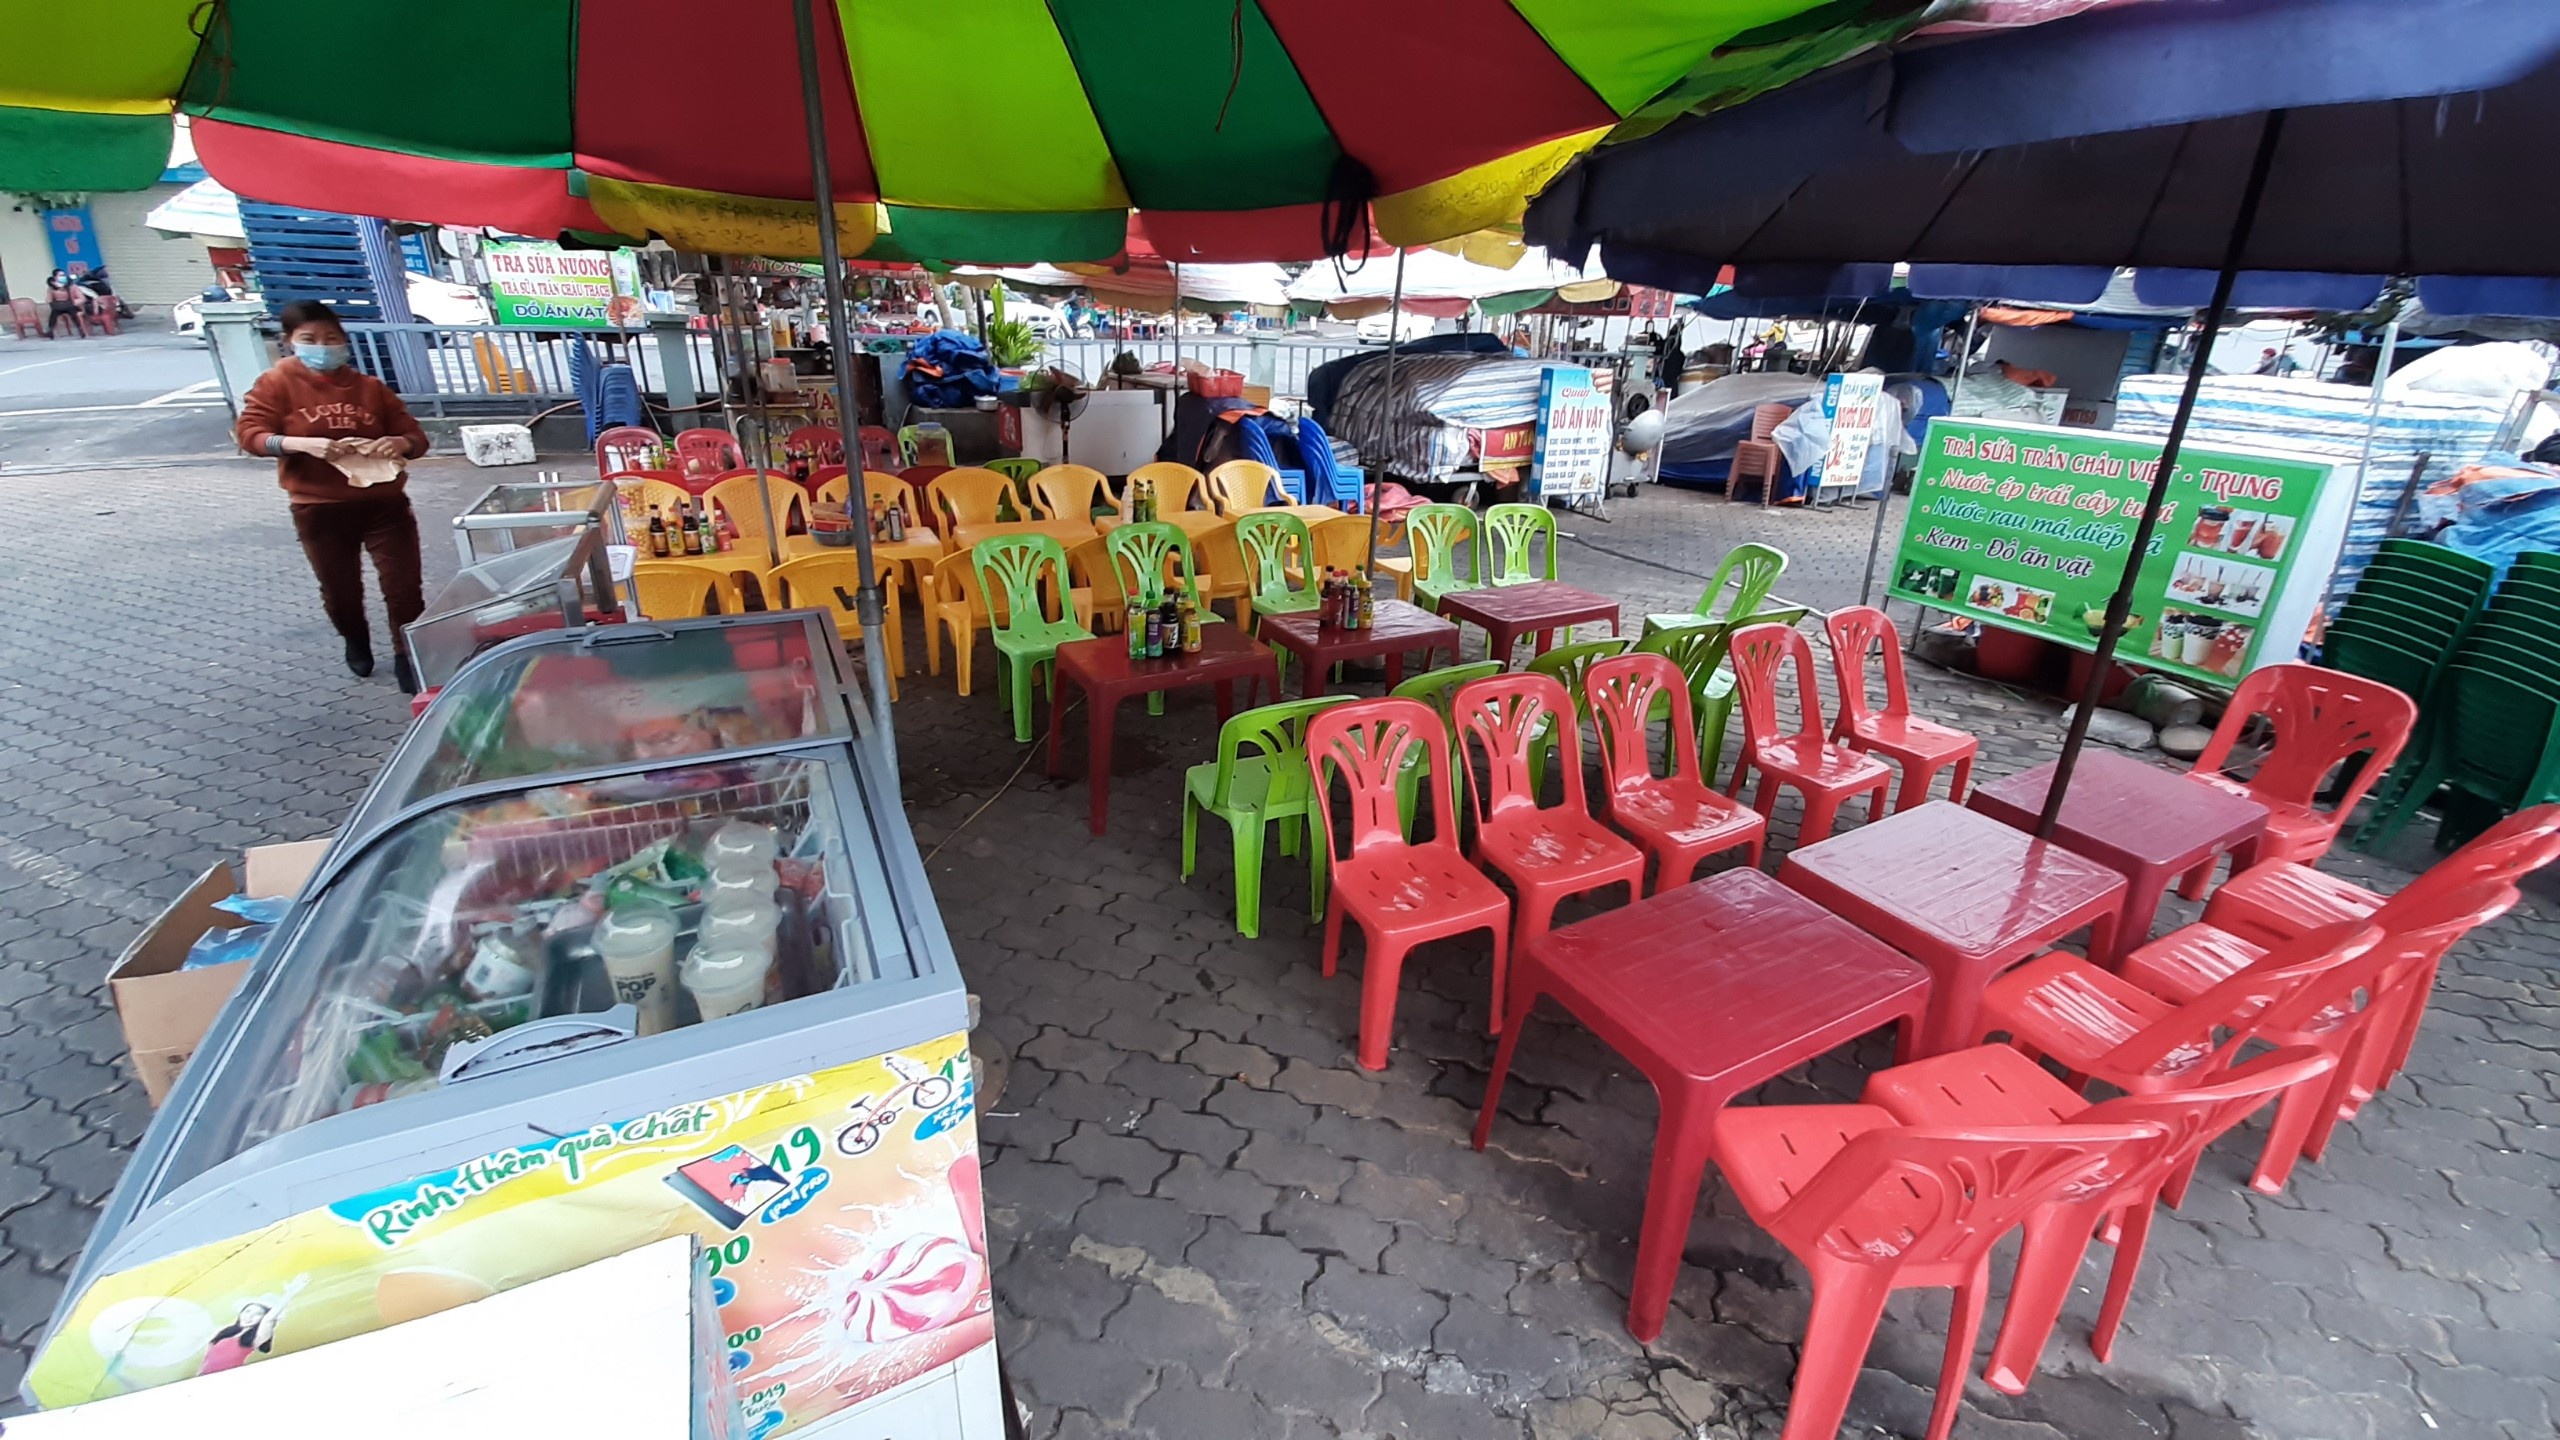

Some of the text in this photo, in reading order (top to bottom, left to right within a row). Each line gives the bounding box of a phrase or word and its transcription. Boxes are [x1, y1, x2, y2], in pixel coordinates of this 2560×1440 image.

[1943, 433, 1975, 457] TRÀ
[1980, 436, 2017, 463] SỮA
[2022, 446, 2067, 471] TRÂN
[2071, 451, 2123, 477] CHÂU
[2199, 468, 2283, 502] TRUNG
[1931, 495, 1986, 522] Nước
[1987, 510, 2027, 529] rau
[1940, 468, 1996, 494] Nước
[1996, 476, 2025, 502] ép
[2027, 481, 2072, 507] trái
[2073, 490, 2119, 519] cây
[1925, 526, 1969, 552] Kem
[1986, 538, 2019, 561] Đồ
[2019, 544, 2049, 569] ăn
[2054, 554, 2095, 580] vặt
[616, 977, 657, 992] POP
[459, 1151, 546, 1192] thêm
[558, 1127, 612, 1180] quà
[768, 1126, 822, 1173] 19
